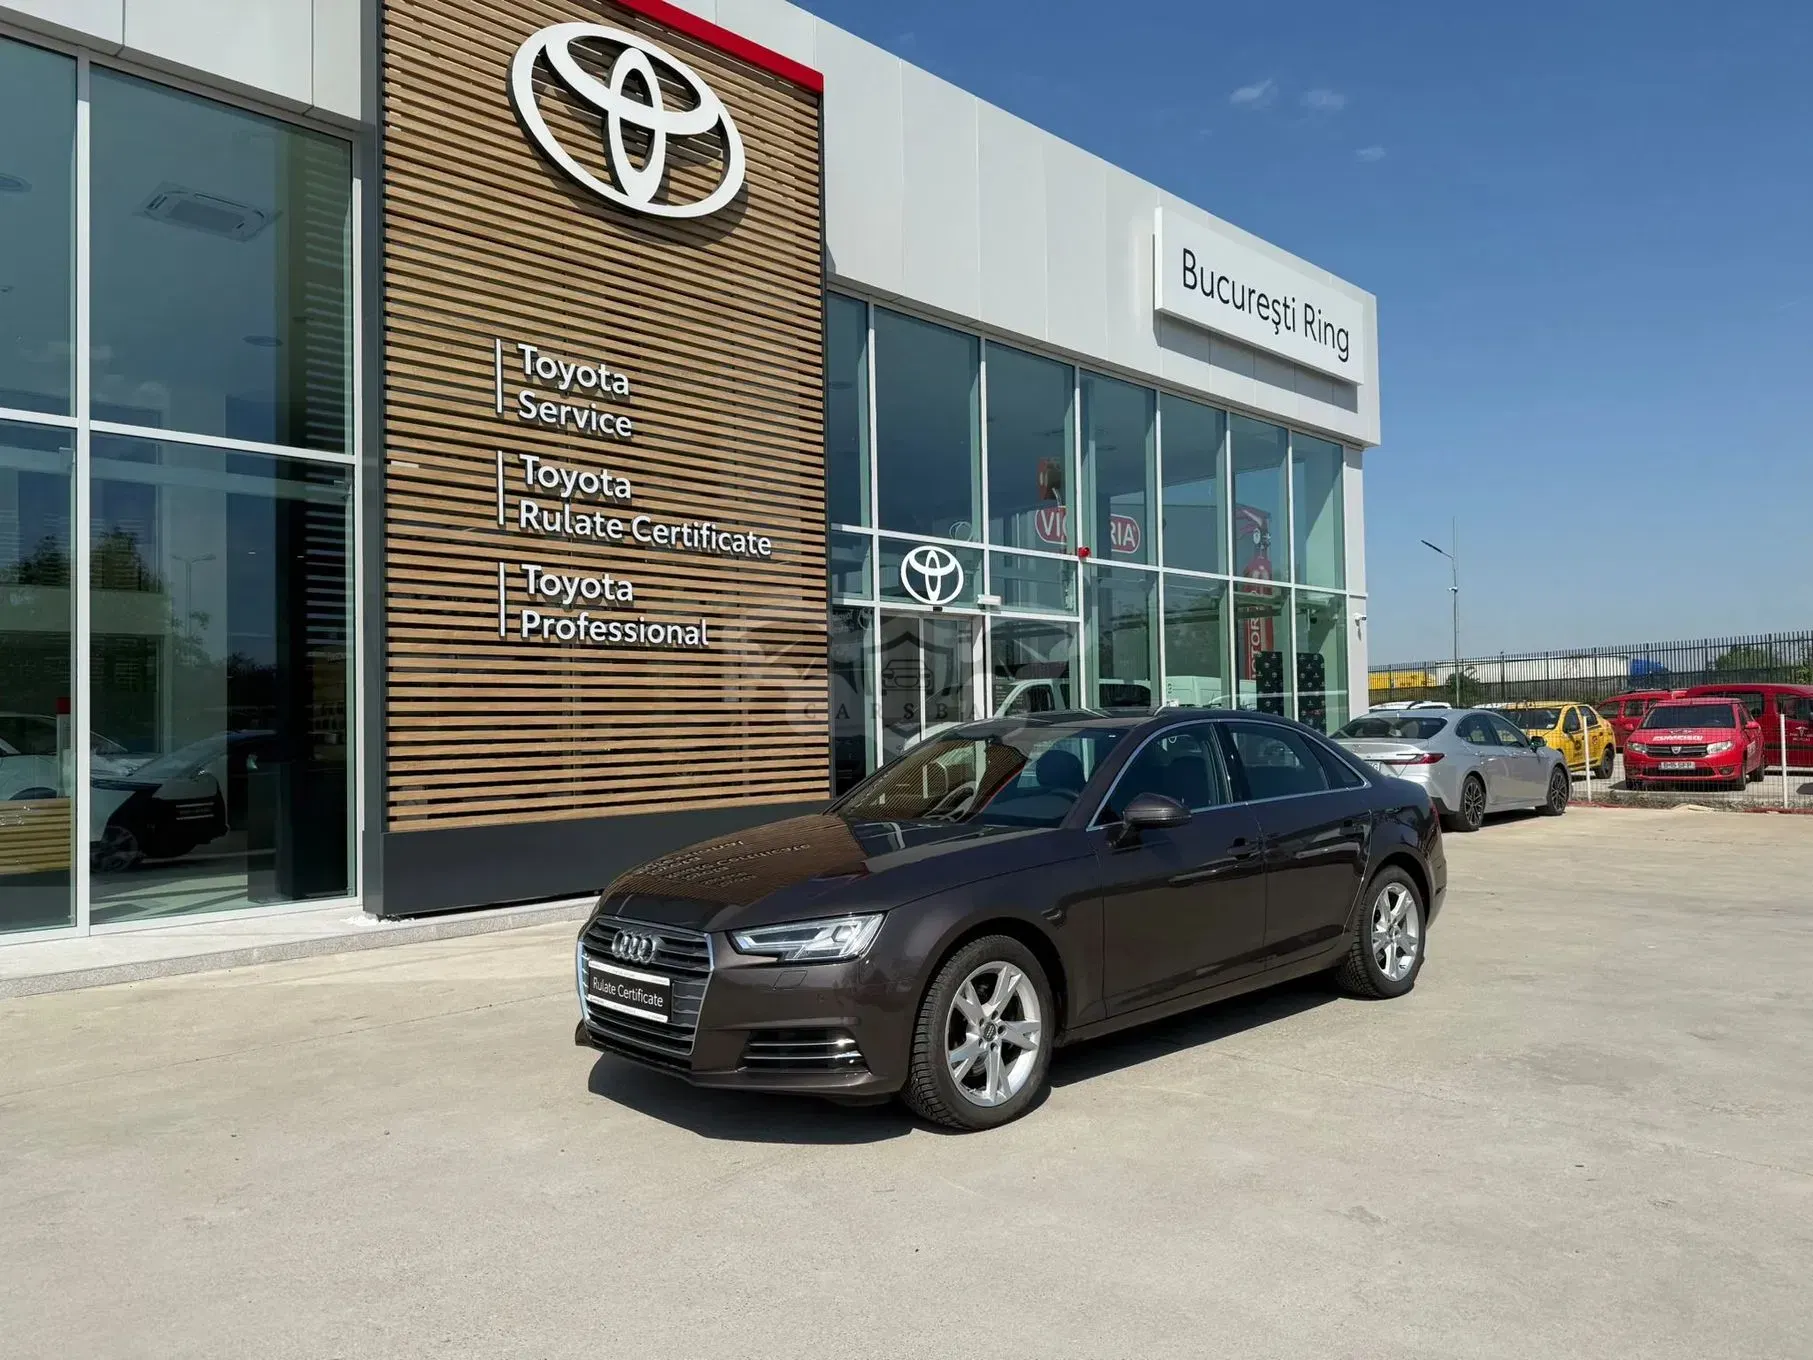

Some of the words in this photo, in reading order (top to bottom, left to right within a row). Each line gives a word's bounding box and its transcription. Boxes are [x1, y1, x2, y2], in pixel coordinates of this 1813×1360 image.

[1304, 302, 1350, 363] Ring
[517, 342, 630, 396] Toyota
[518, 390, 633, 438] Service
[518, 453, 632, 499] Toyota
[519, 500, 623, 540] Rulate
[631, 515, 772, 556] Certificate
[520, 563, 634, 604] Toyota
[520, 609, 709, 646] Professional
[592, 976, 617, 996] Rulate
[617, 983, 664, 1008] Certificate
